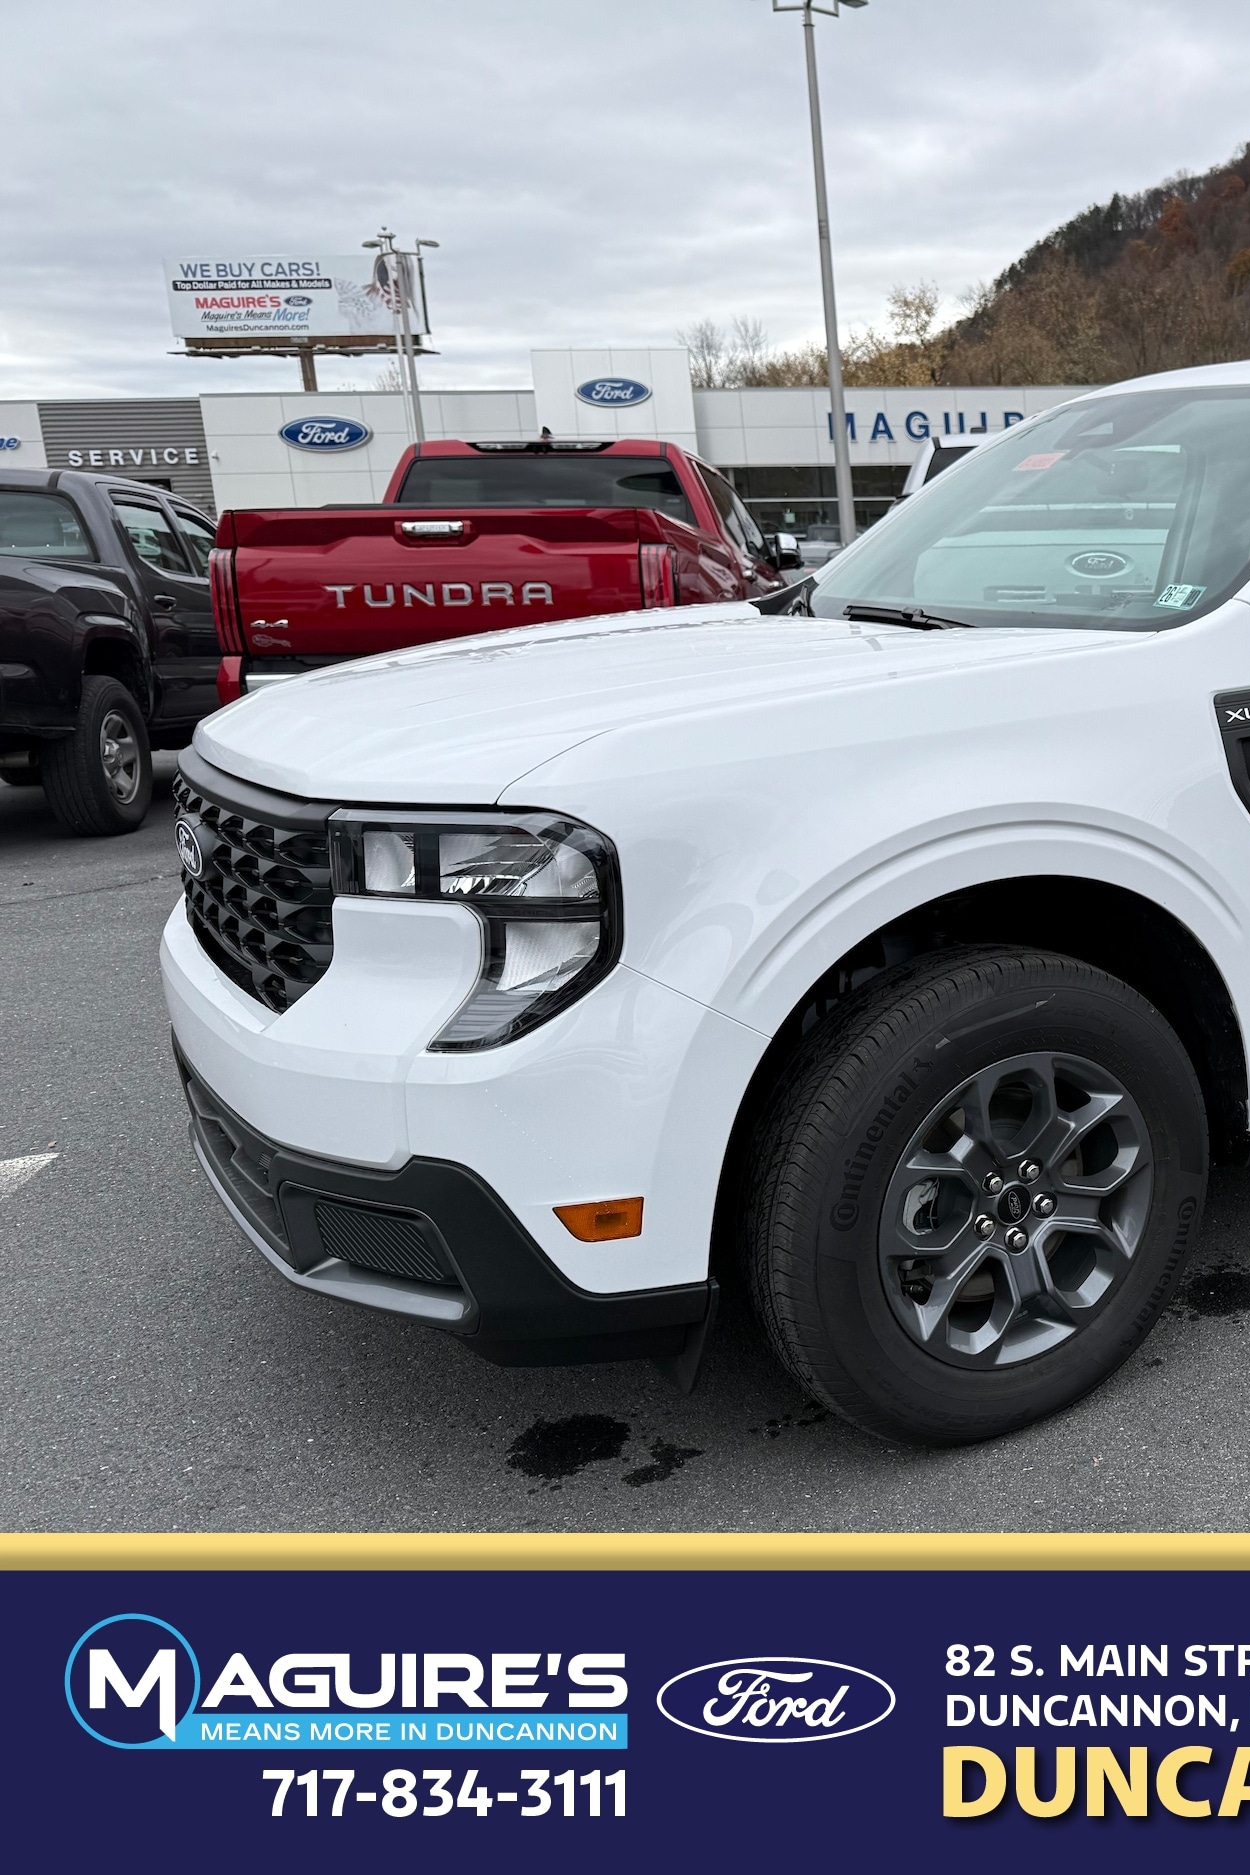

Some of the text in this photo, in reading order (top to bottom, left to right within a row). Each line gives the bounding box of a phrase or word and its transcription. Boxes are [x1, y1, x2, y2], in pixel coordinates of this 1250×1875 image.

[179, 262, 321, 278] WE BUY CARS!
[175, 279, 330, 290] Top Dollar Paid for All Makes & Models
[195, 294, 308, 309] MAGUIRE'S Ford
[200, 307, 311, 323] Maguire's Means More!
[206, 323, 310, 333] MaguiresDuncannon.com
[592, 380, 635, 401] Ford
[299, 421, 350, 445] Ford
[68, 447, 200, 467] SERVICE
[323, 580, 555, 609] TUNDRA
[178, 826, 198, 870] Ford
[830, 1070, 919, 1233] Continental
[1130, 1195, 1197, 1334] Continental
